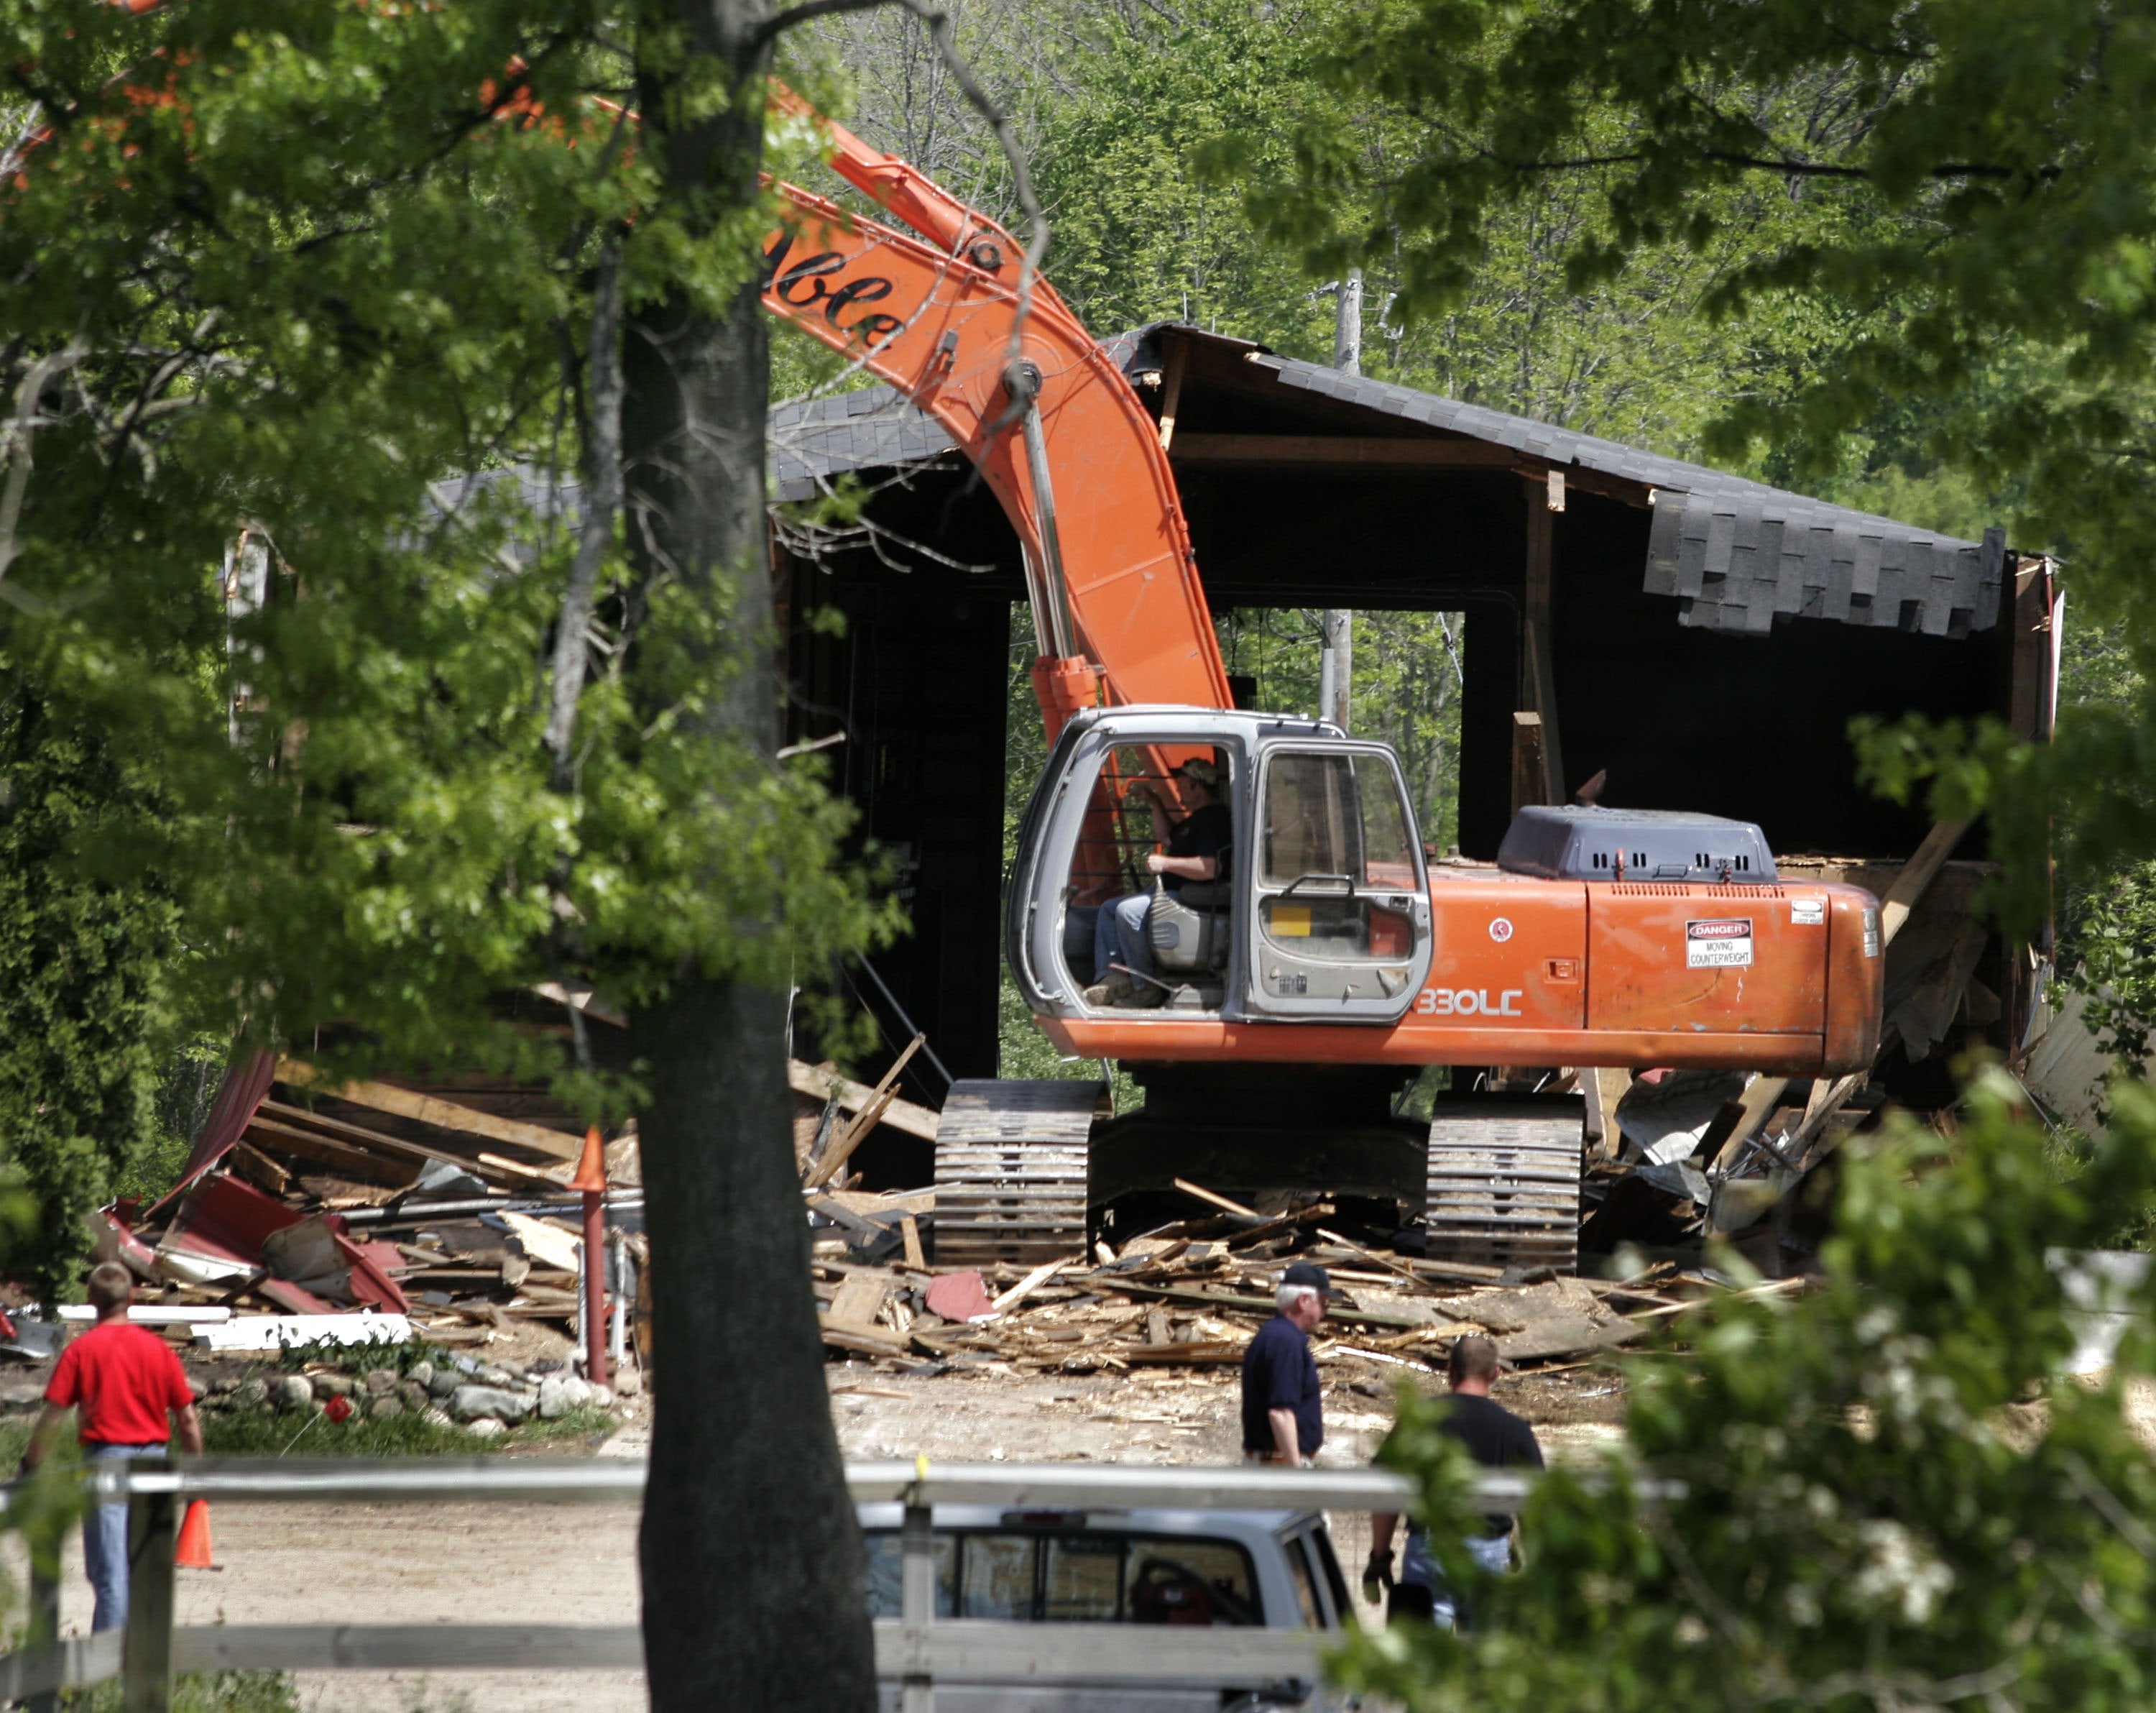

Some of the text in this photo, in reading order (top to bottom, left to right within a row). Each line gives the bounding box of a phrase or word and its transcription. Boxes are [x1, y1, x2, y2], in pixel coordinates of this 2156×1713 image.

[1696, 925, 1742, 935] DANGER
[1706, 941, 1733, 951] MOVING
[1690, 952, 1749, 964] COUNTERWEIGHT
[1416, 988, 1523, 1016] 330LC
